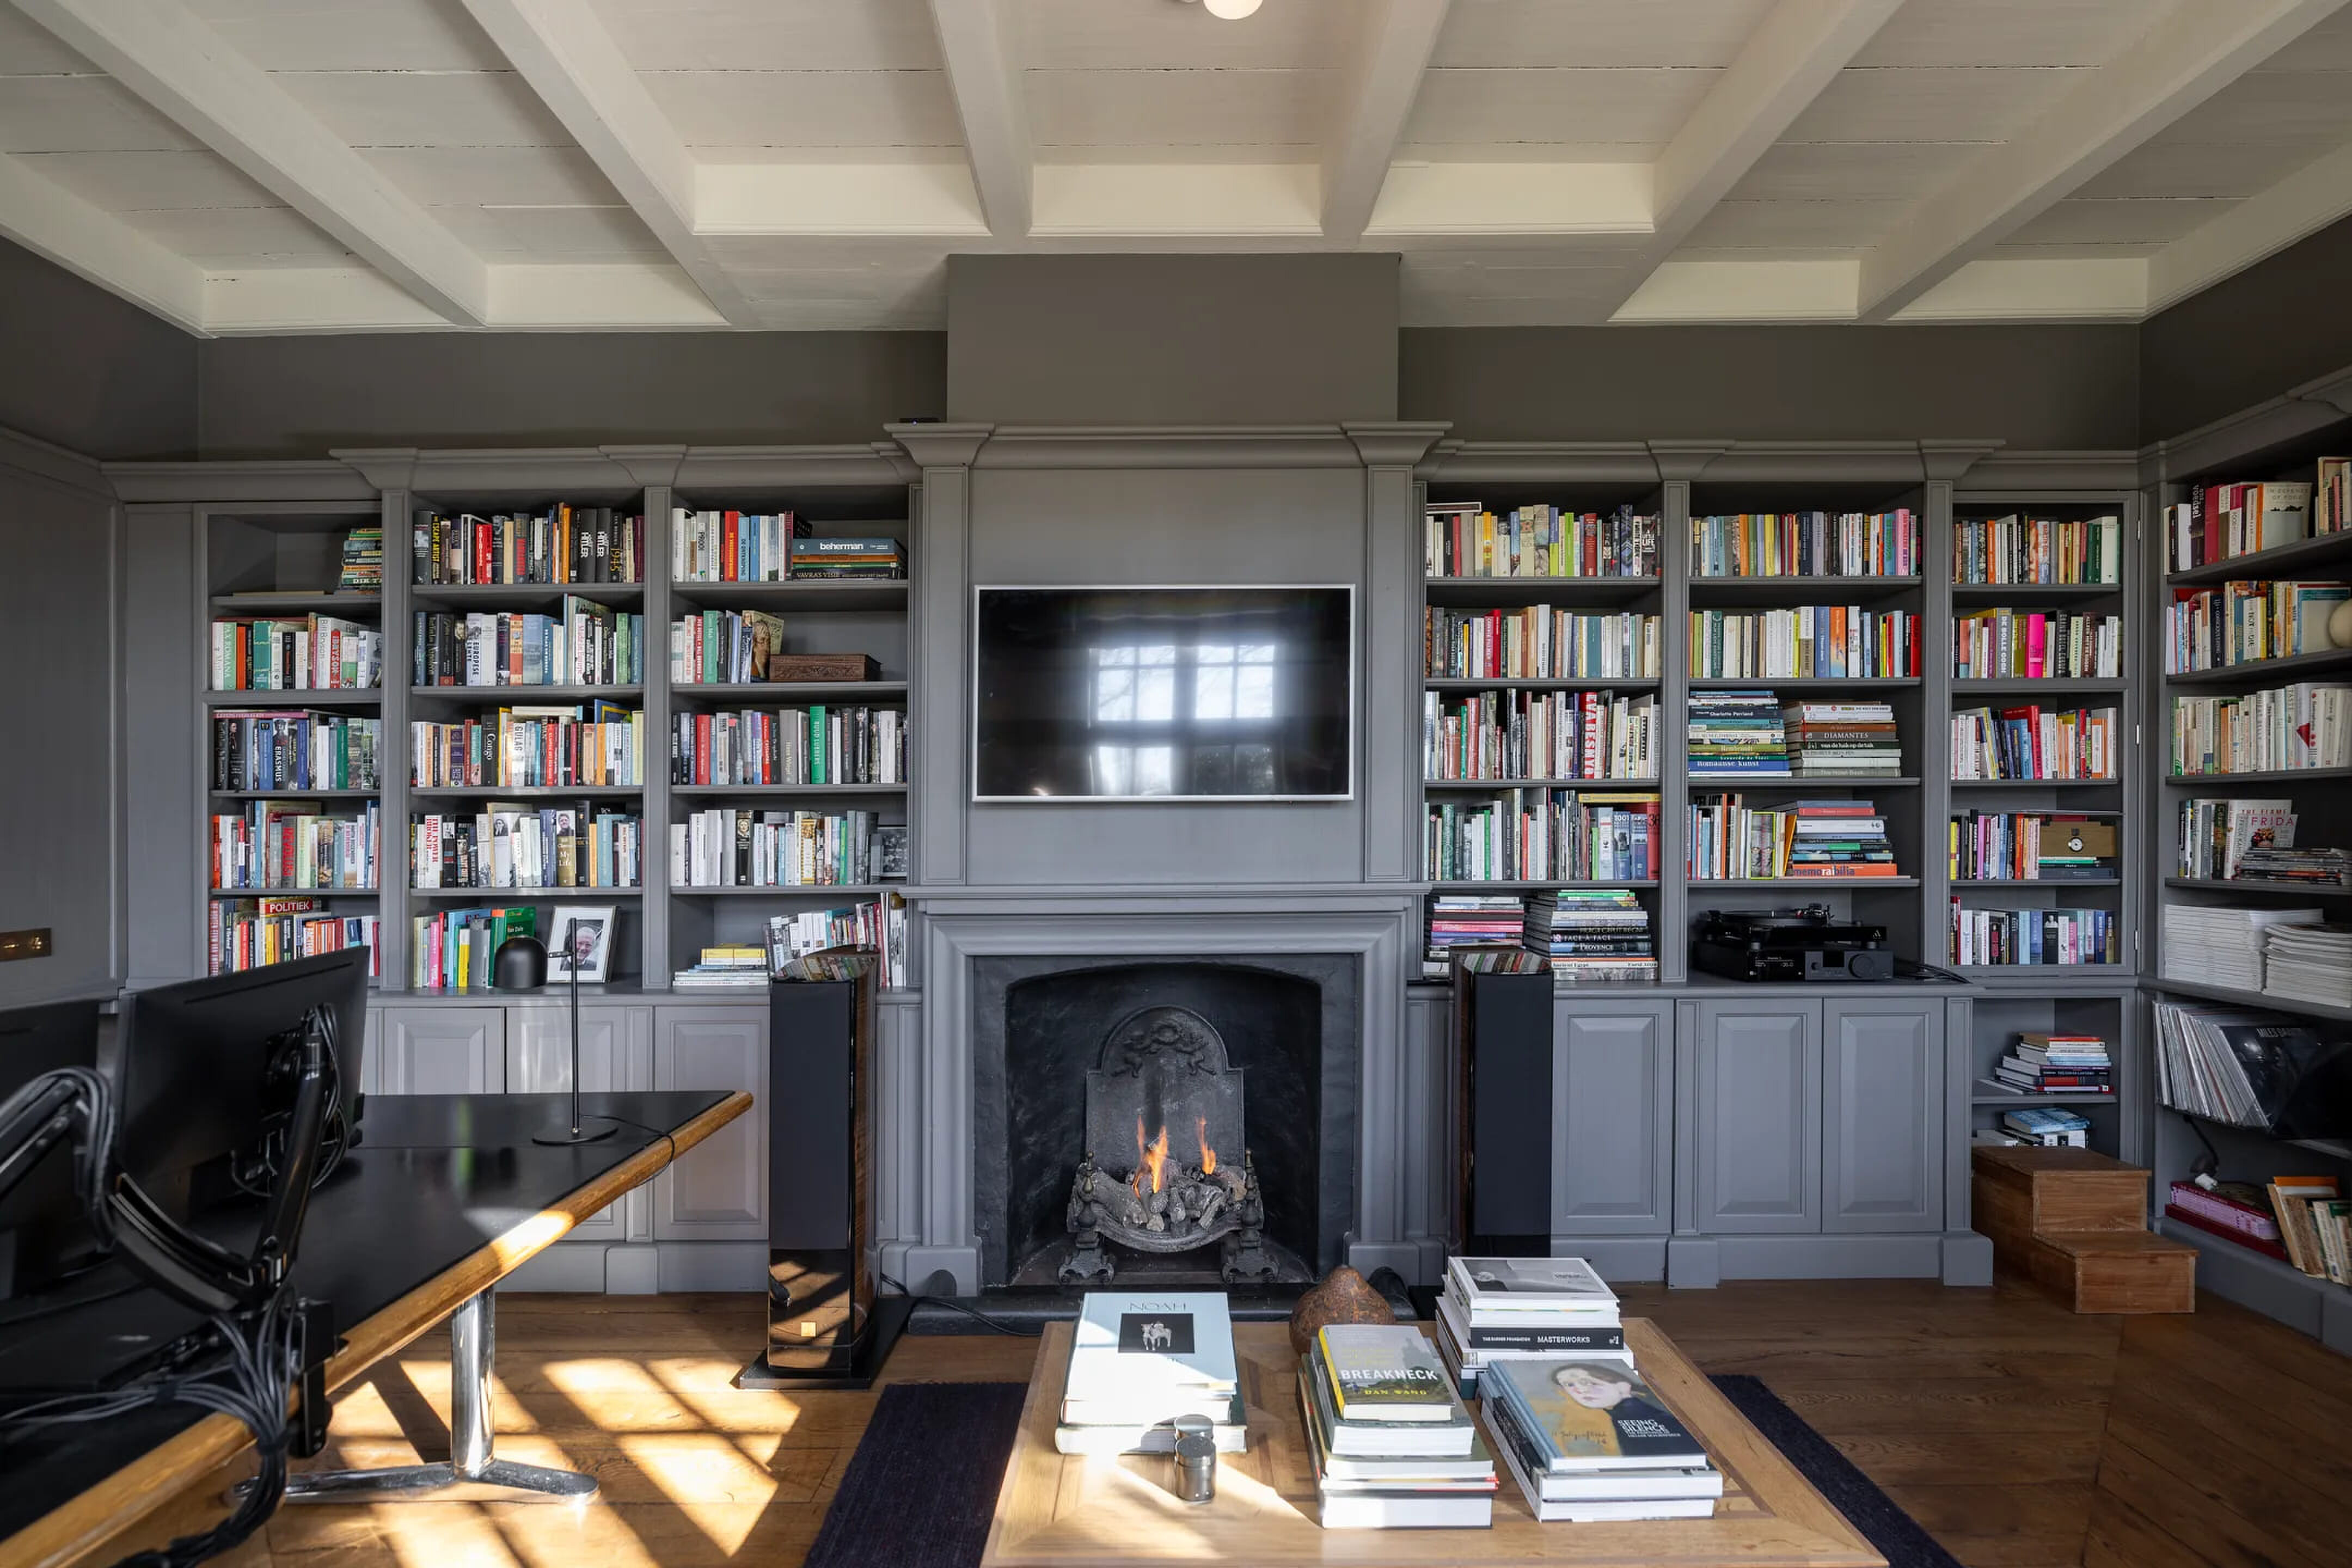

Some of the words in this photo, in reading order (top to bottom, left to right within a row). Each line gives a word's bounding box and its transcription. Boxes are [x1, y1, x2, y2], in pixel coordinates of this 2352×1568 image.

[2192, 485, 2201, 518] voedsel
[581, 532, 589, 558] HITLER
[597, 531, 605, 558] HITLER
[610, 549, 620, 571] 1945
[320, 618, 328, 632] Bill
[2001, 616, 2007, 626] DE
[318, 632, 328, 659] Bryson
[428, 646, 438, 674] Napoleon
[1585, 694, 1597, 720] EVA
[485, 733, 496, 760] Congo
[514, 726, 523, 751] GULAG
[2251, 817, 2294, 826] FRIDA
[283, 827, 295, 876] REVOLUSI
[1794, 865, 1855, 876] memorabilia
[270, 901, 309, 913] POLITIEK
[2256, 1028, 2281, 1037] MILES
[1129, 1302, 1186, 1311] NOAH
[1341, 1369, 1438, 1380] BREAKNECK
